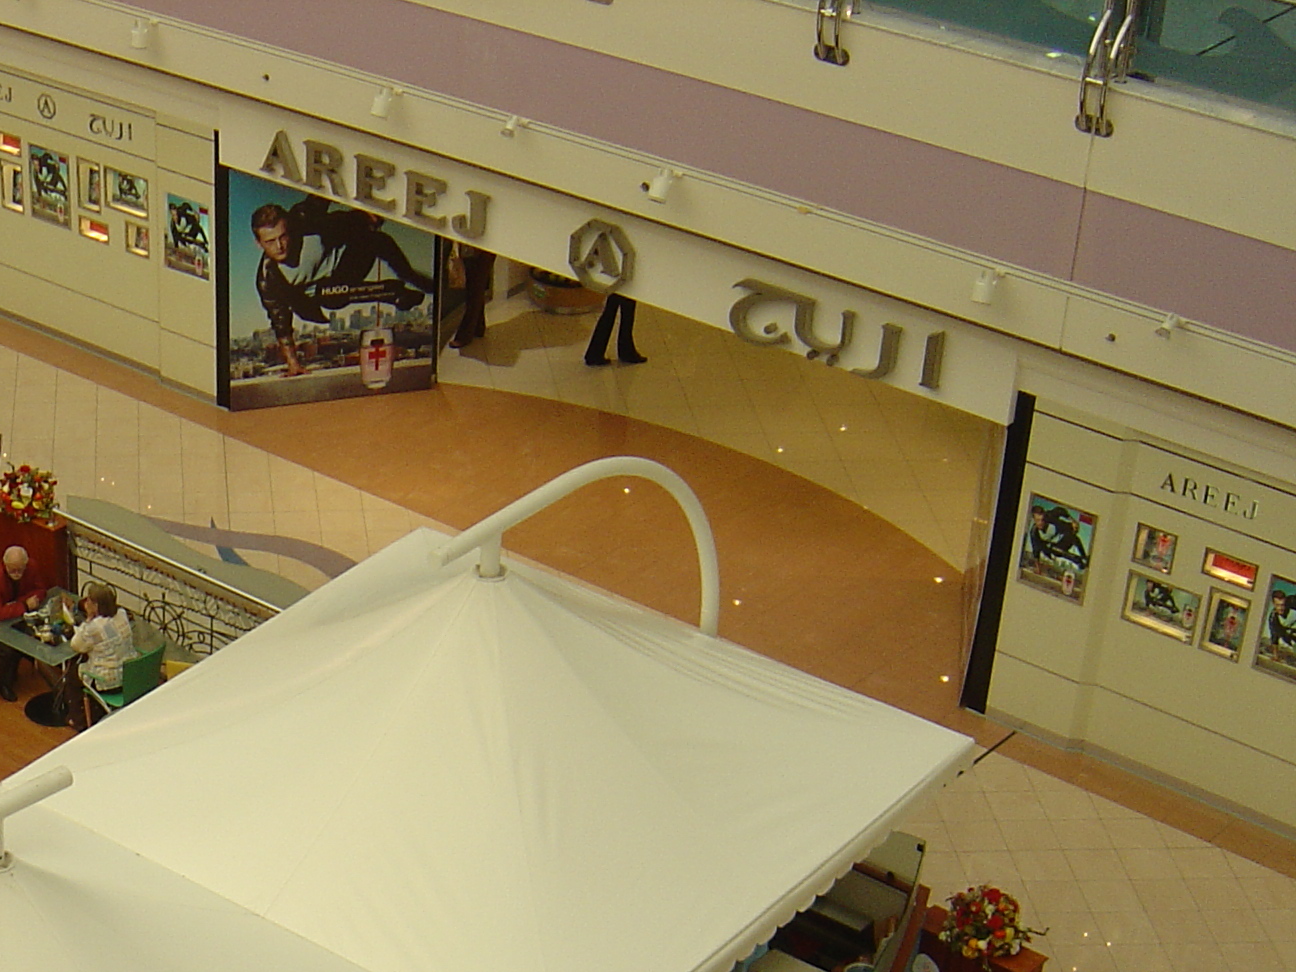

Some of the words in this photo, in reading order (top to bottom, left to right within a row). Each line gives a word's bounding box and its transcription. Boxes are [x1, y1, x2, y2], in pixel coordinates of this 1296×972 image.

[260, 129, 491, 239] AREEJ
[321, 284, 349, 296] HUGO
[1160, 472, 1260, 520] AREEJ
